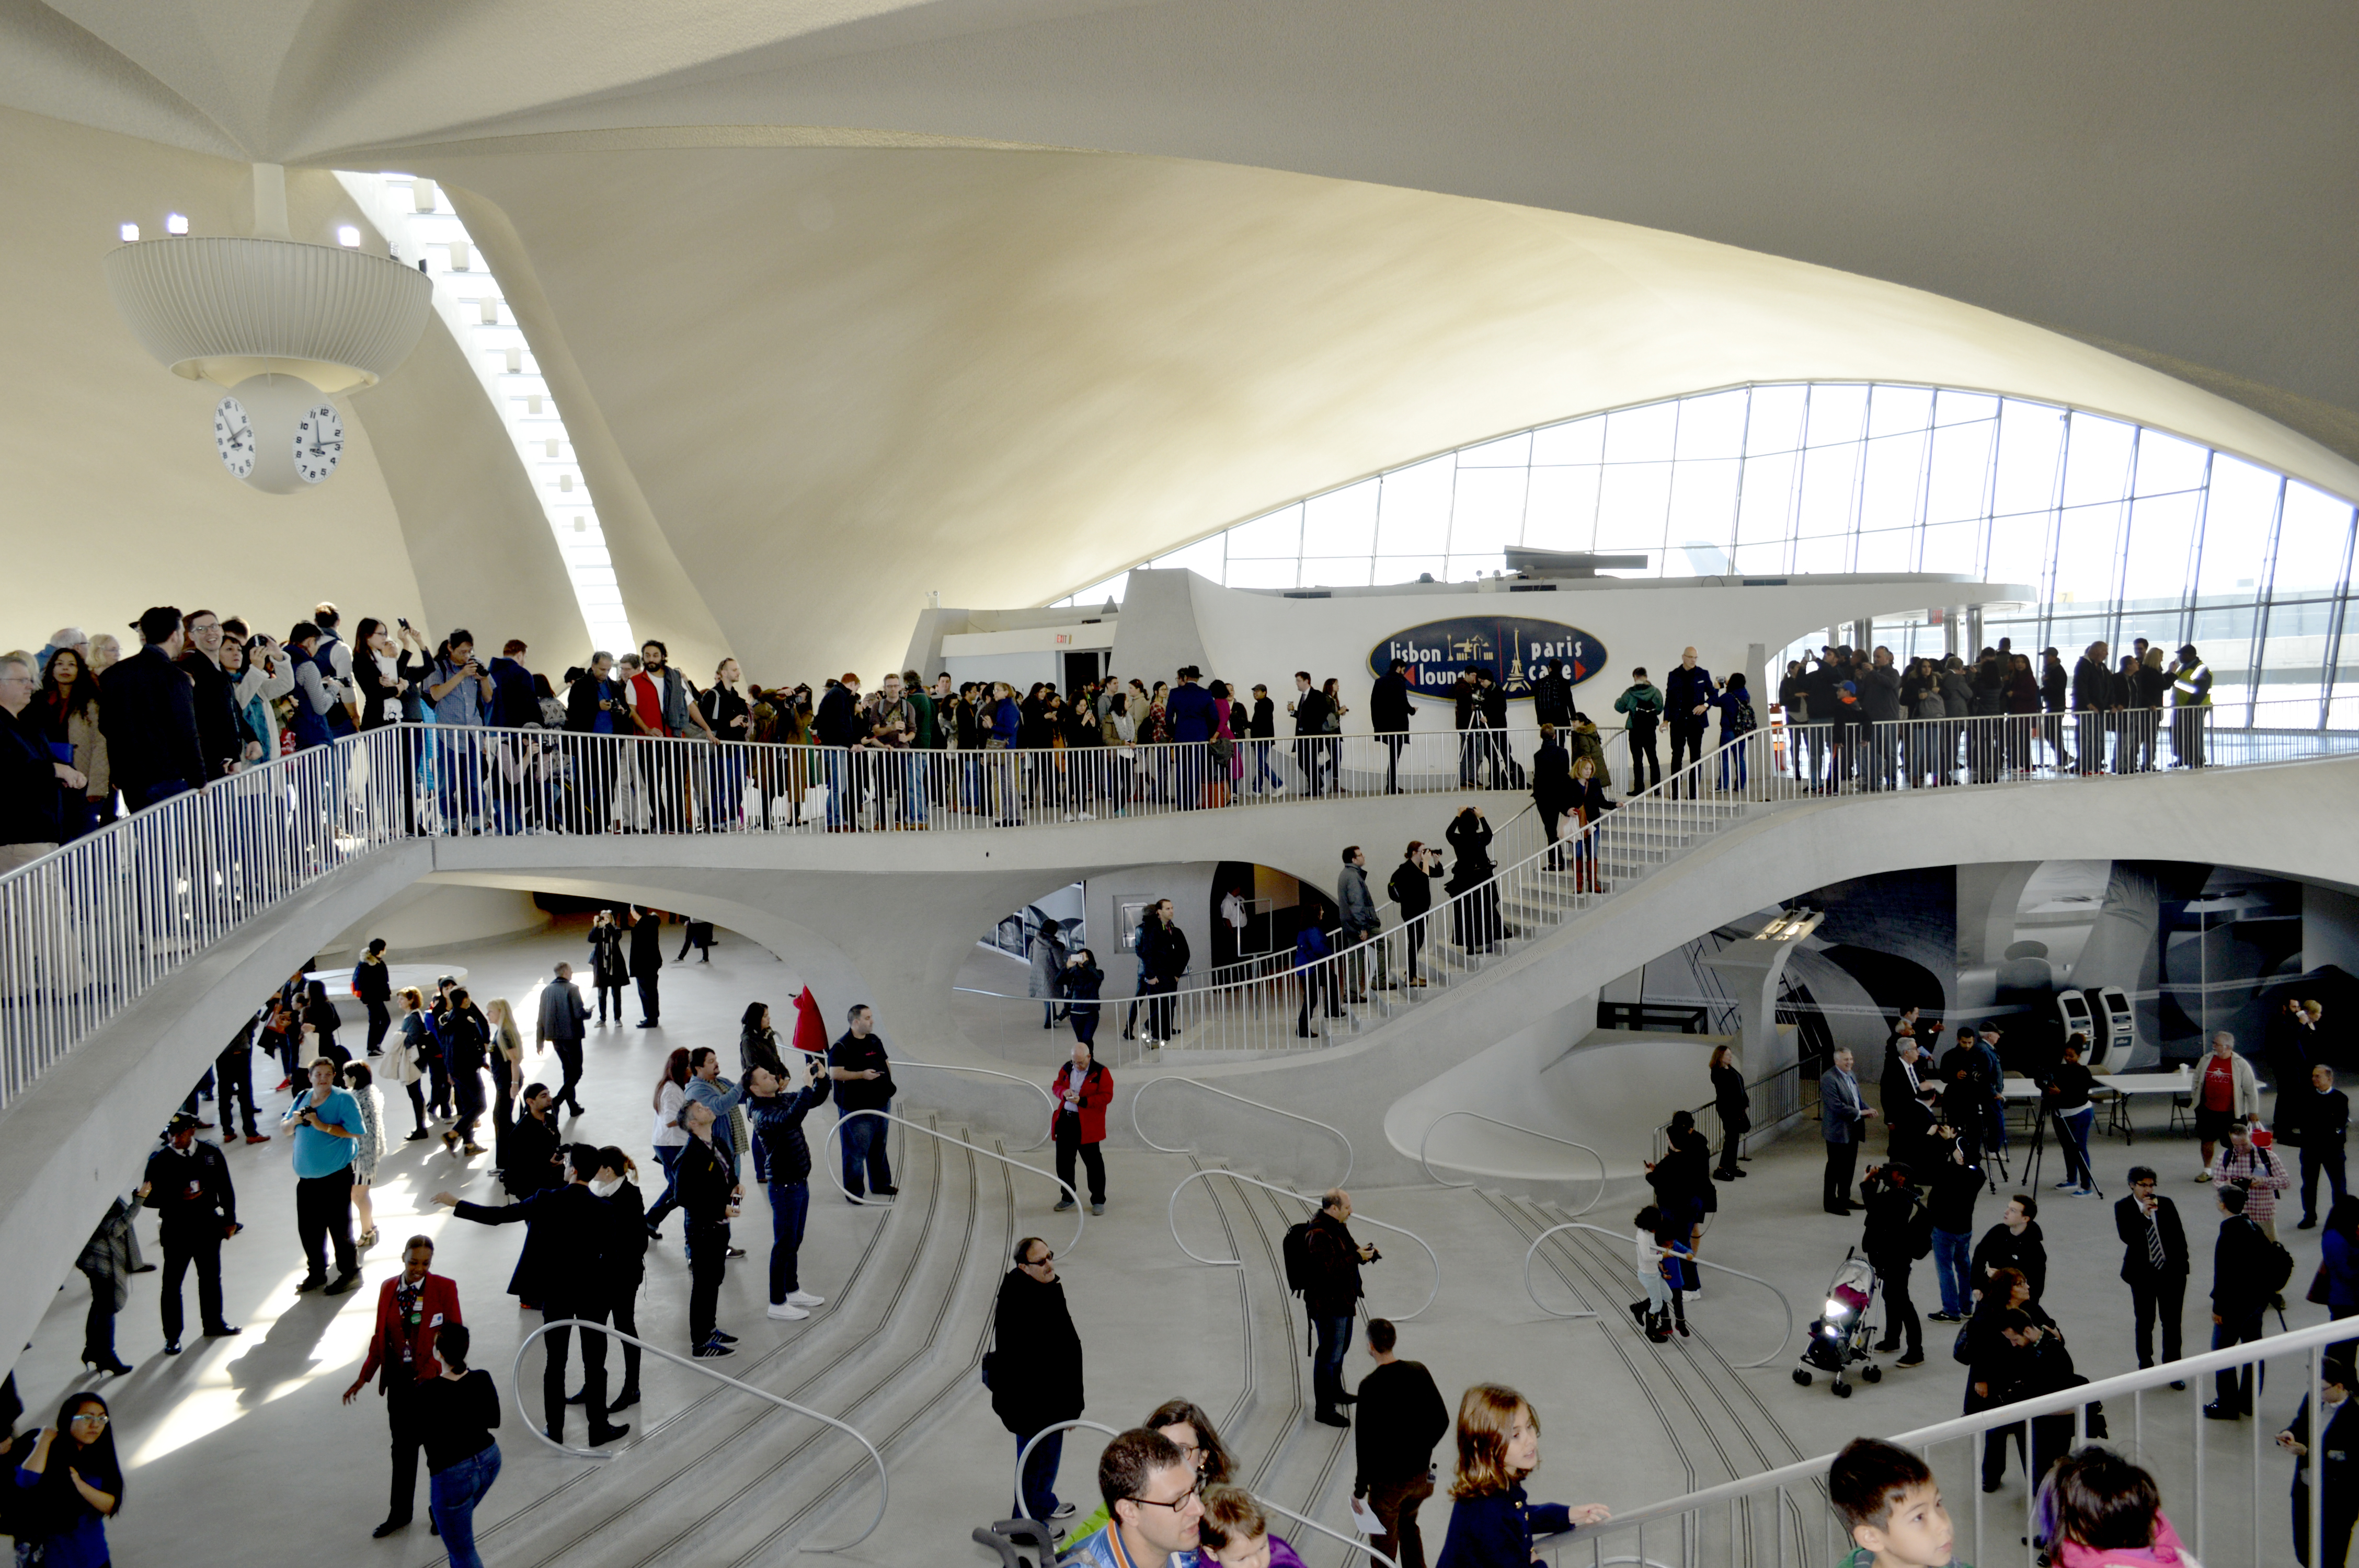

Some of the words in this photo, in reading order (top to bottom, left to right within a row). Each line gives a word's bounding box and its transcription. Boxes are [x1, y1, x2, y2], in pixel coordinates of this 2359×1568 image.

[320, 408, 329, 417] 12
[216, 423, 223, 431] 10
[301, 421, 308, 430] 10
[247, 429, 252, 437] 3
[2062, 593, 2067, 603] 7
[1932, 610, 1943, 623] EXIT
[1057, 635, 1067, 643] EXIT
[1391, 641, 1441, 663] lisbon
[1531, 636, 1582, 661] paris
[1529, 664, 1571, 681] cae
